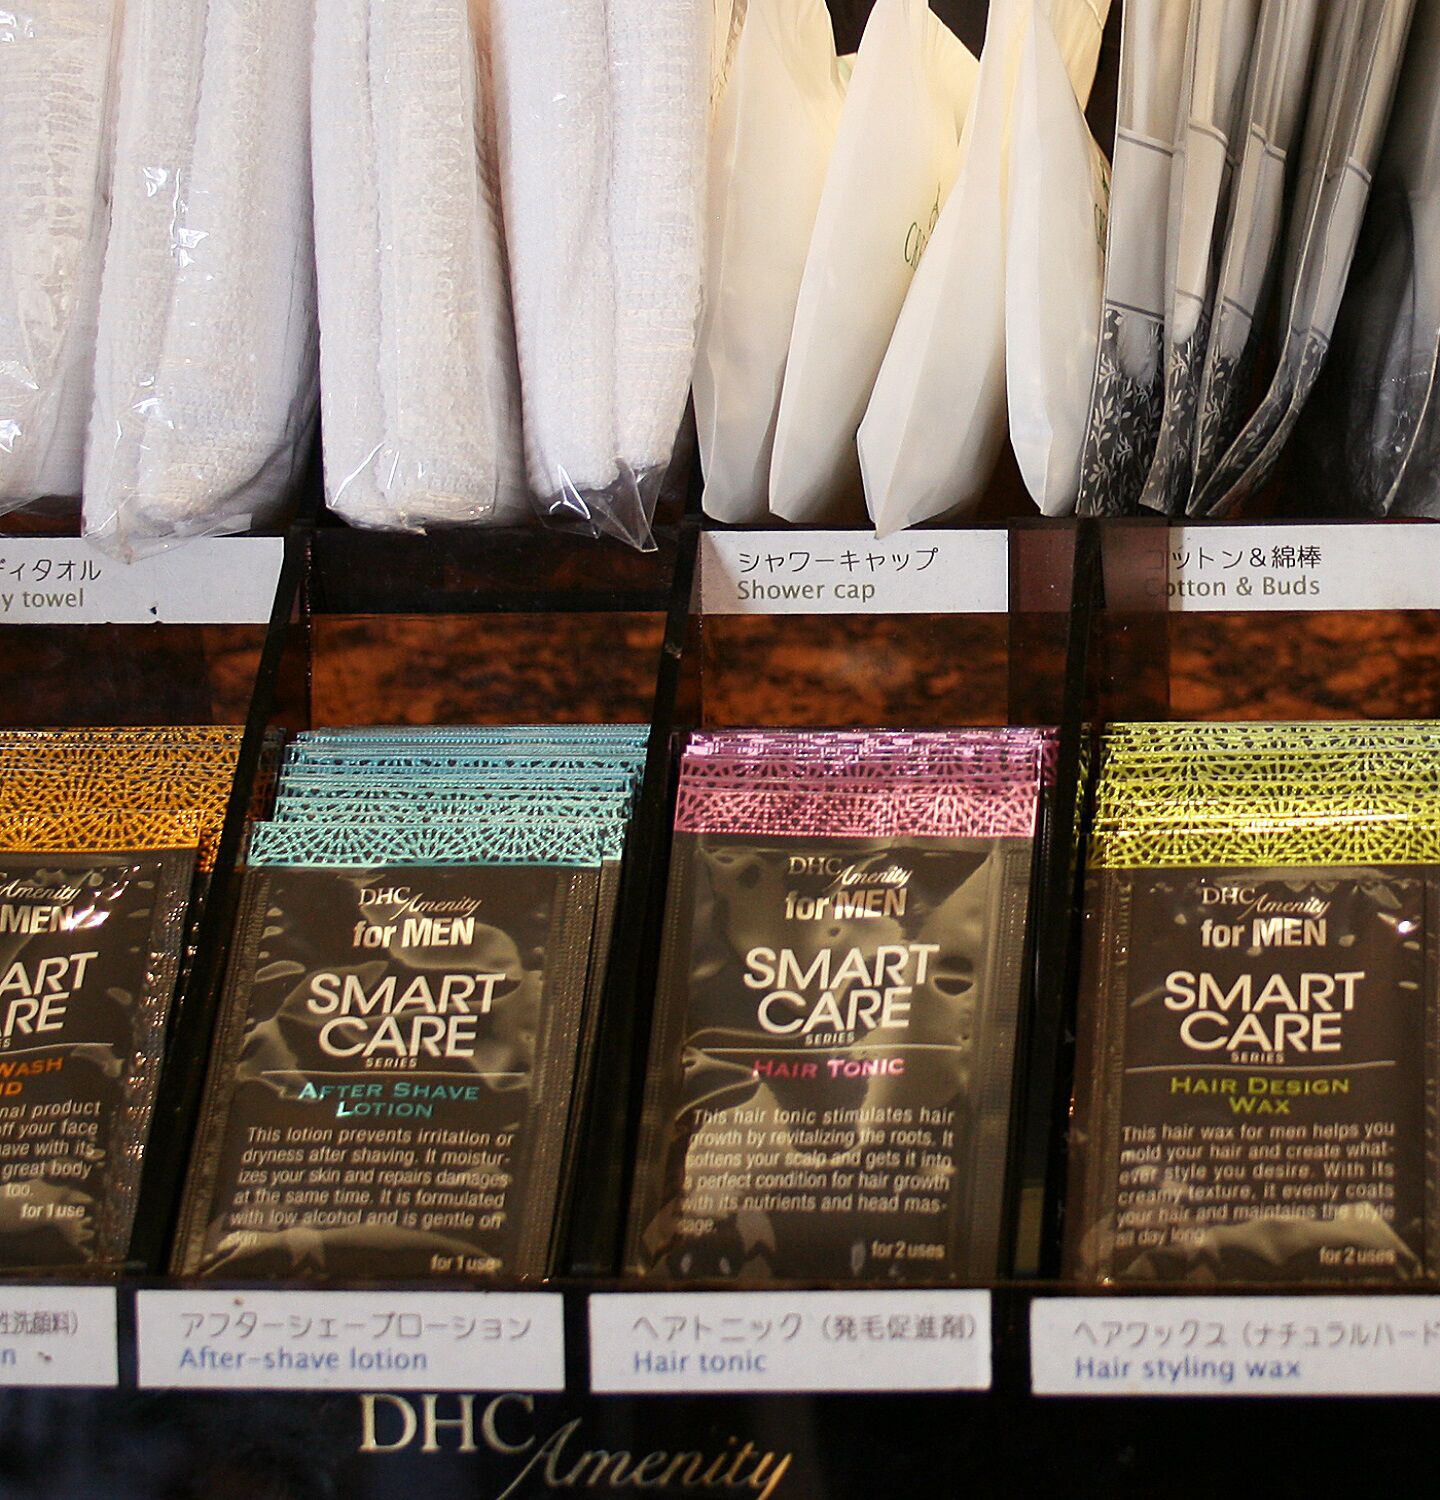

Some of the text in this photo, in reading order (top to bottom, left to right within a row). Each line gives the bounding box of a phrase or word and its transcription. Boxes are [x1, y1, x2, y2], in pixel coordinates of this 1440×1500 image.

[739, 548, 938, 572] シャワーキャップ
[23, 588, 84, 607] towel
[738, 580, 874, 602] Shower cap
[1236, 576, 1252, 596] &
[1262, 575, 1320, 595] Buds
[789, 856, 913, 891] DHC Amenity
[359, 887, 482, 921] DHC Amenity
[785, 888, 907, 921] for MEN
[1202, 887, 1331, 921] DHC Amenity
[353, 917, 475, 948] for MEN
[1201, 918, 1327, 947] for MEN
[743, 944, 940, 989] SMART
[307, 973, 506, 1016] SMART
[1164, 971, 1365, 1012] SMART
[757, 987, 913, 1034] CARE
[318, 1016, 478, 1057] CARE
[805, 1032, 855, 1046] SERIES
[1180, 1010, 1342, 1052] CARE
[365, 1058, 418, 1069] SERIES
[1231, 1052, 1284, 1064] SERIES
[32, 1100, 100, 1118] product
[734, 1108, 815, 1124] hair tonic
[61, 1120, 98, 1136] face
[248, 1127, 411, 1145] This lotion prevents
[1240, 1122, 1395, 1141] for helps you
[34, 1139, 71, 1156] with
[51, 1162, 92, 1180] body
[180, 1346, 428, 1370] After-shave lotion
[634, 1351, 766, 1373] Hair tonic
[1076, 1356, 1301, 1384] Hair styling wax
[359, 1393, 792, 1500] DHC Amenity
